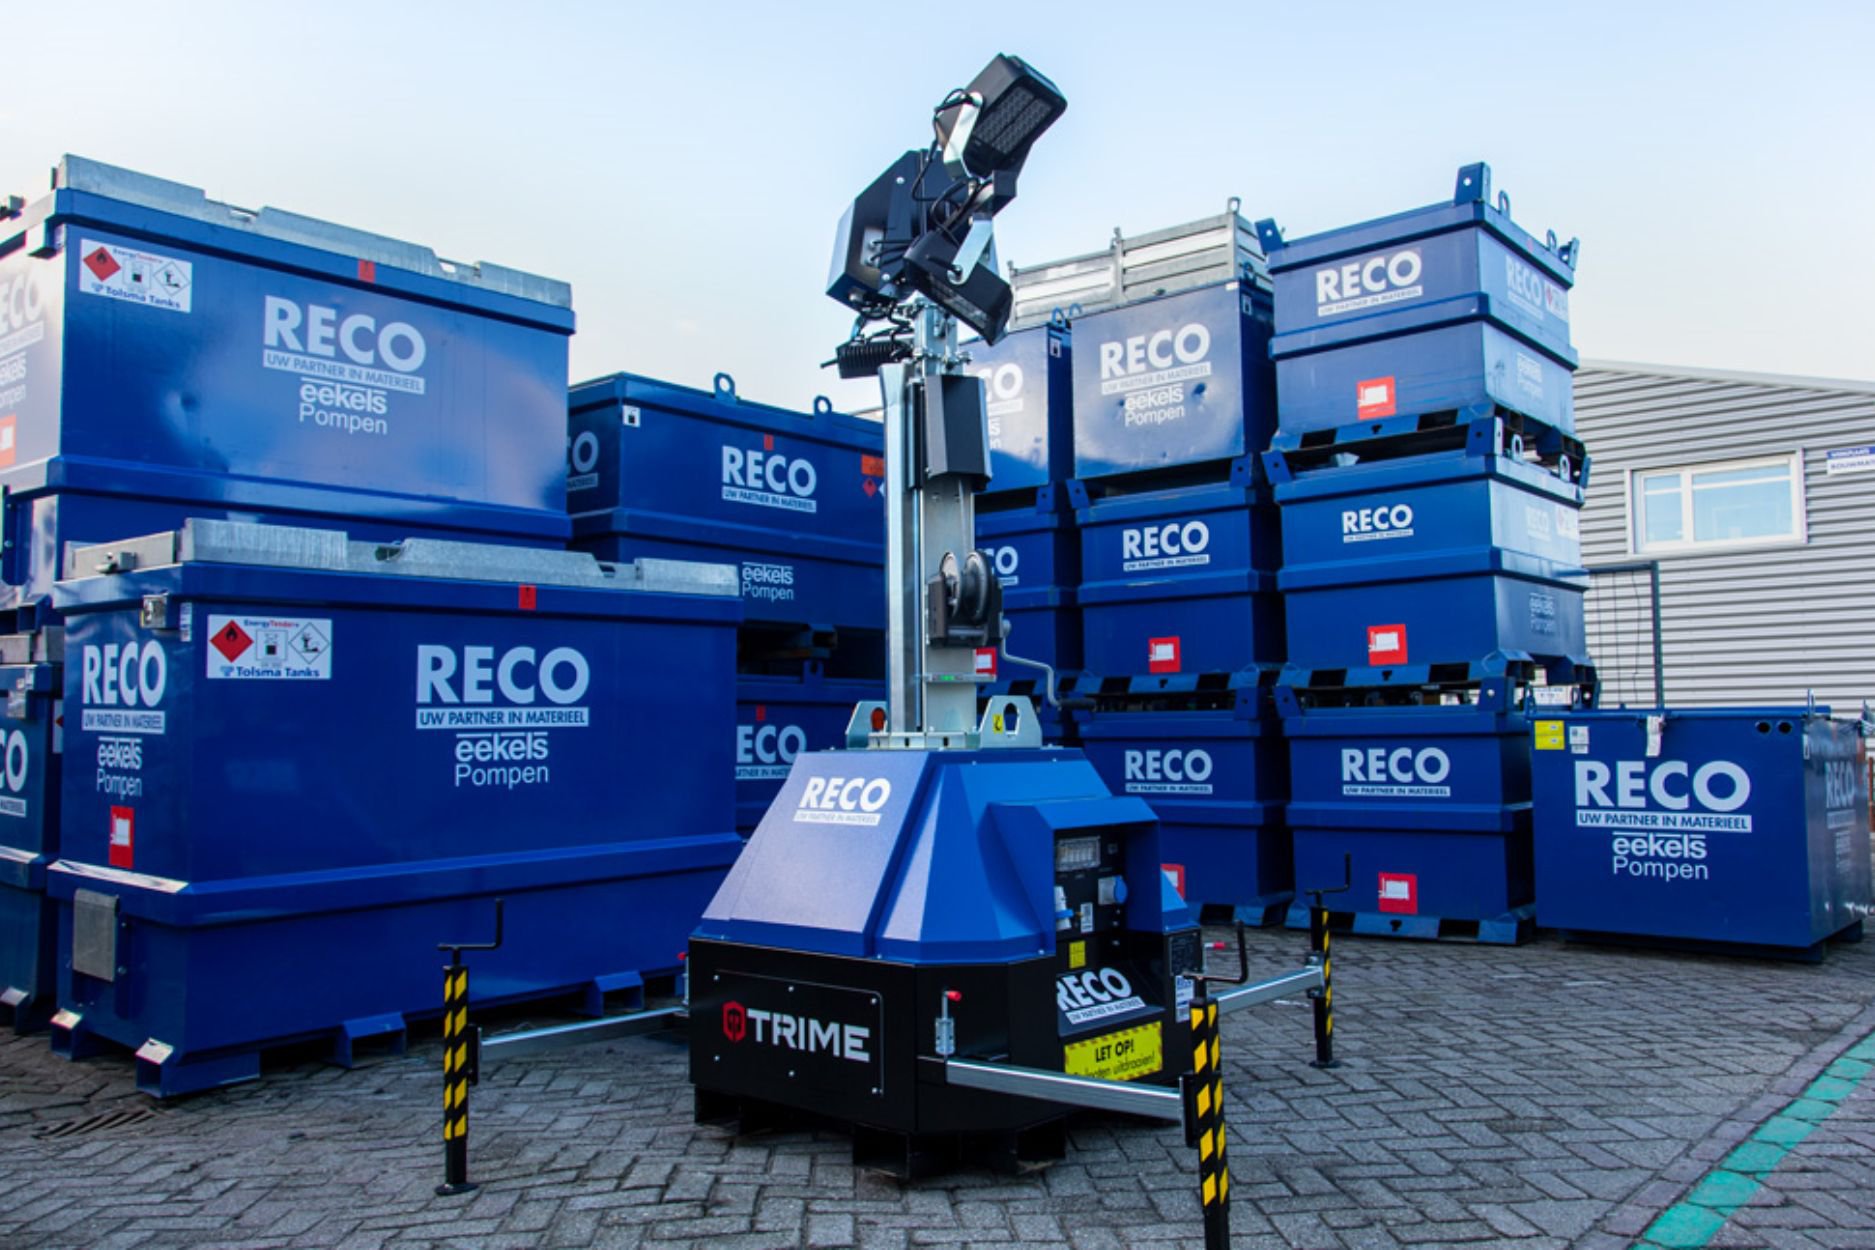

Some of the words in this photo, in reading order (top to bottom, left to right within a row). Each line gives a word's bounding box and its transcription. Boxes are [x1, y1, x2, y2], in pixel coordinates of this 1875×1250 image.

[1316, 250, 1421, 304] RECO
[1506, 254, 1542, 306] RECO
[0, 267, 42, 336] ECO
[106, 286, 146, 302] Tolsma
[149, 295, 181, 308] Tanks
[263, 295, 427, 373] RECO
[1100, 323, 1210, 379] RECO
[267, 354, 291, 368] UW
[294, 359, 346, 377] PARTNER
[348, 367, 362, 381] IN
[366, 371, 422, 391] MATERIEEL
[300, 379, 388, 414] eekels
[1125, 385, 1184, 410] eekels
[299, 402, 388, 435] Pompen
[1124, 406, 1185, 427] Pompen
[722, 445, 817, 497] RECO
[1342, 504, 1413, 533] RECO
[1123, 521, 1209, 559] RECO
[742, 563, 794, 585] eekels
[742, 581, 794, 603] Pompen
[82, 640, 167, 707] RECO
[237, 666, 281, 677] Tolsma
[286, 666, 320, 677] Tanks
[416, 645, 590, 704] RECO
[420, 711, 445, 726] UW
[449, 711, 504, 725] PARTNER
[508, 711, 523, 724] IN
[526, 710, 585, 724] MATERIEEL
[97, 738, 143, 770] eekels
[455, 732, 549, 762] eekels
[736, 725, 807, 763] ECO
[455, 764, 549, 790] Pompen
[1125, 749, 1213, 781] RECO
[1341, 747, 1450, 783] RECO
[97, 768, 143, 800] Pompen
[798, 776, 891, 812] RECO
[1574, 760, 1751, 812] RECO
[1825, 760, 1855, 808] RECO
[1579, 813, 1600, 824] UW
[1605, 813, 1658, 826] PARTNER
[1662, 815, 1675, 826] IN
[1681, 815, 1748, 829] MATERIEEL
[1612, 831, 1707, 859] eekels
[1612, 856, 1709, 882] Pompen
[1056, 967, 1132, 1011] RECO
[746, 1008, 871, 1063] TRIME
[1095, 1044, 1112, 1063] LET
[1115, 1038, 1134, 1056] OP!
